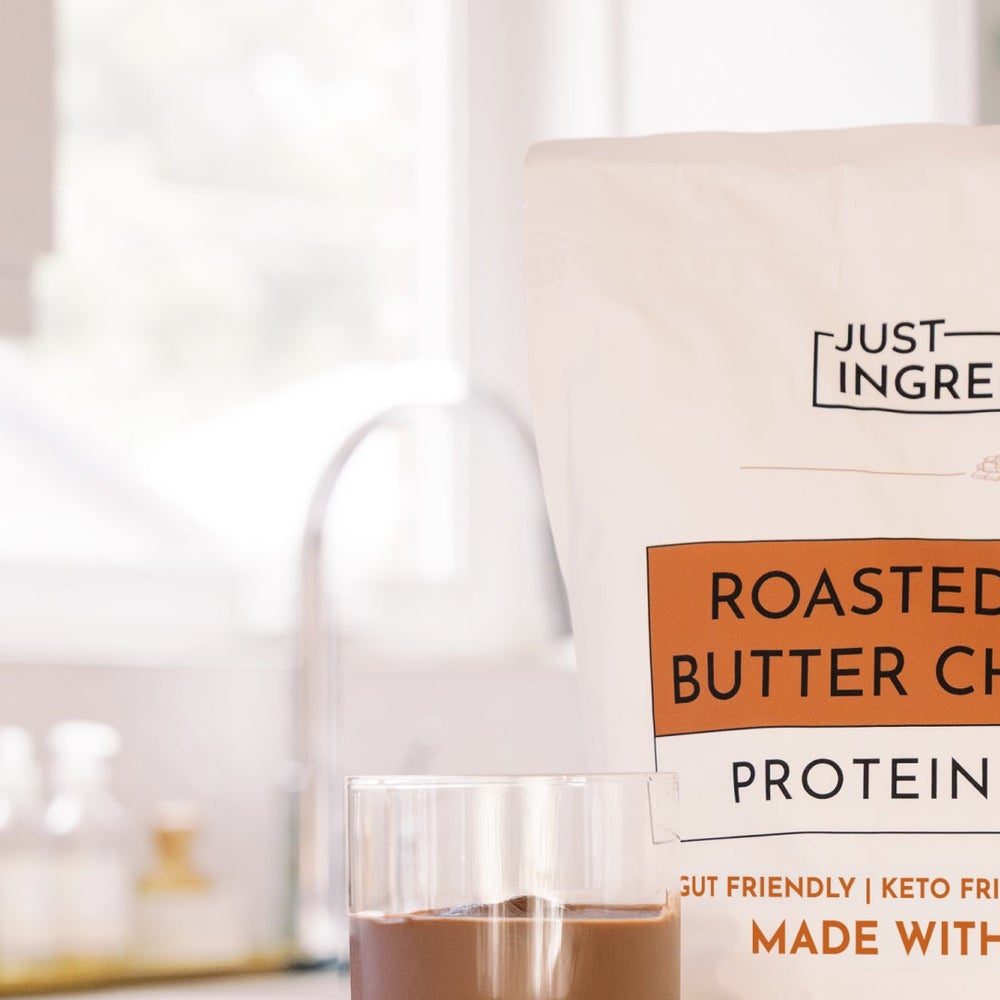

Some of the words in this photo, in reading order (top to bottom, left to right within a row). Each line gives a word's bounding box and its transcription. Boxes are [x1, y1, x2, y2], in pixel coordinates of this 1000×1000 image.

[836, 319, 945, 354] JUST
[673, 646, 908, 704] BUTTER
[733, 757, 988, 803] PROTEIN
[680, 876, 718, 897] GUT
[727, 876, 856, 898] FRIENDLY
[882, 876, 956, 900] KETO
[752, 919, 878, 955] MADE
